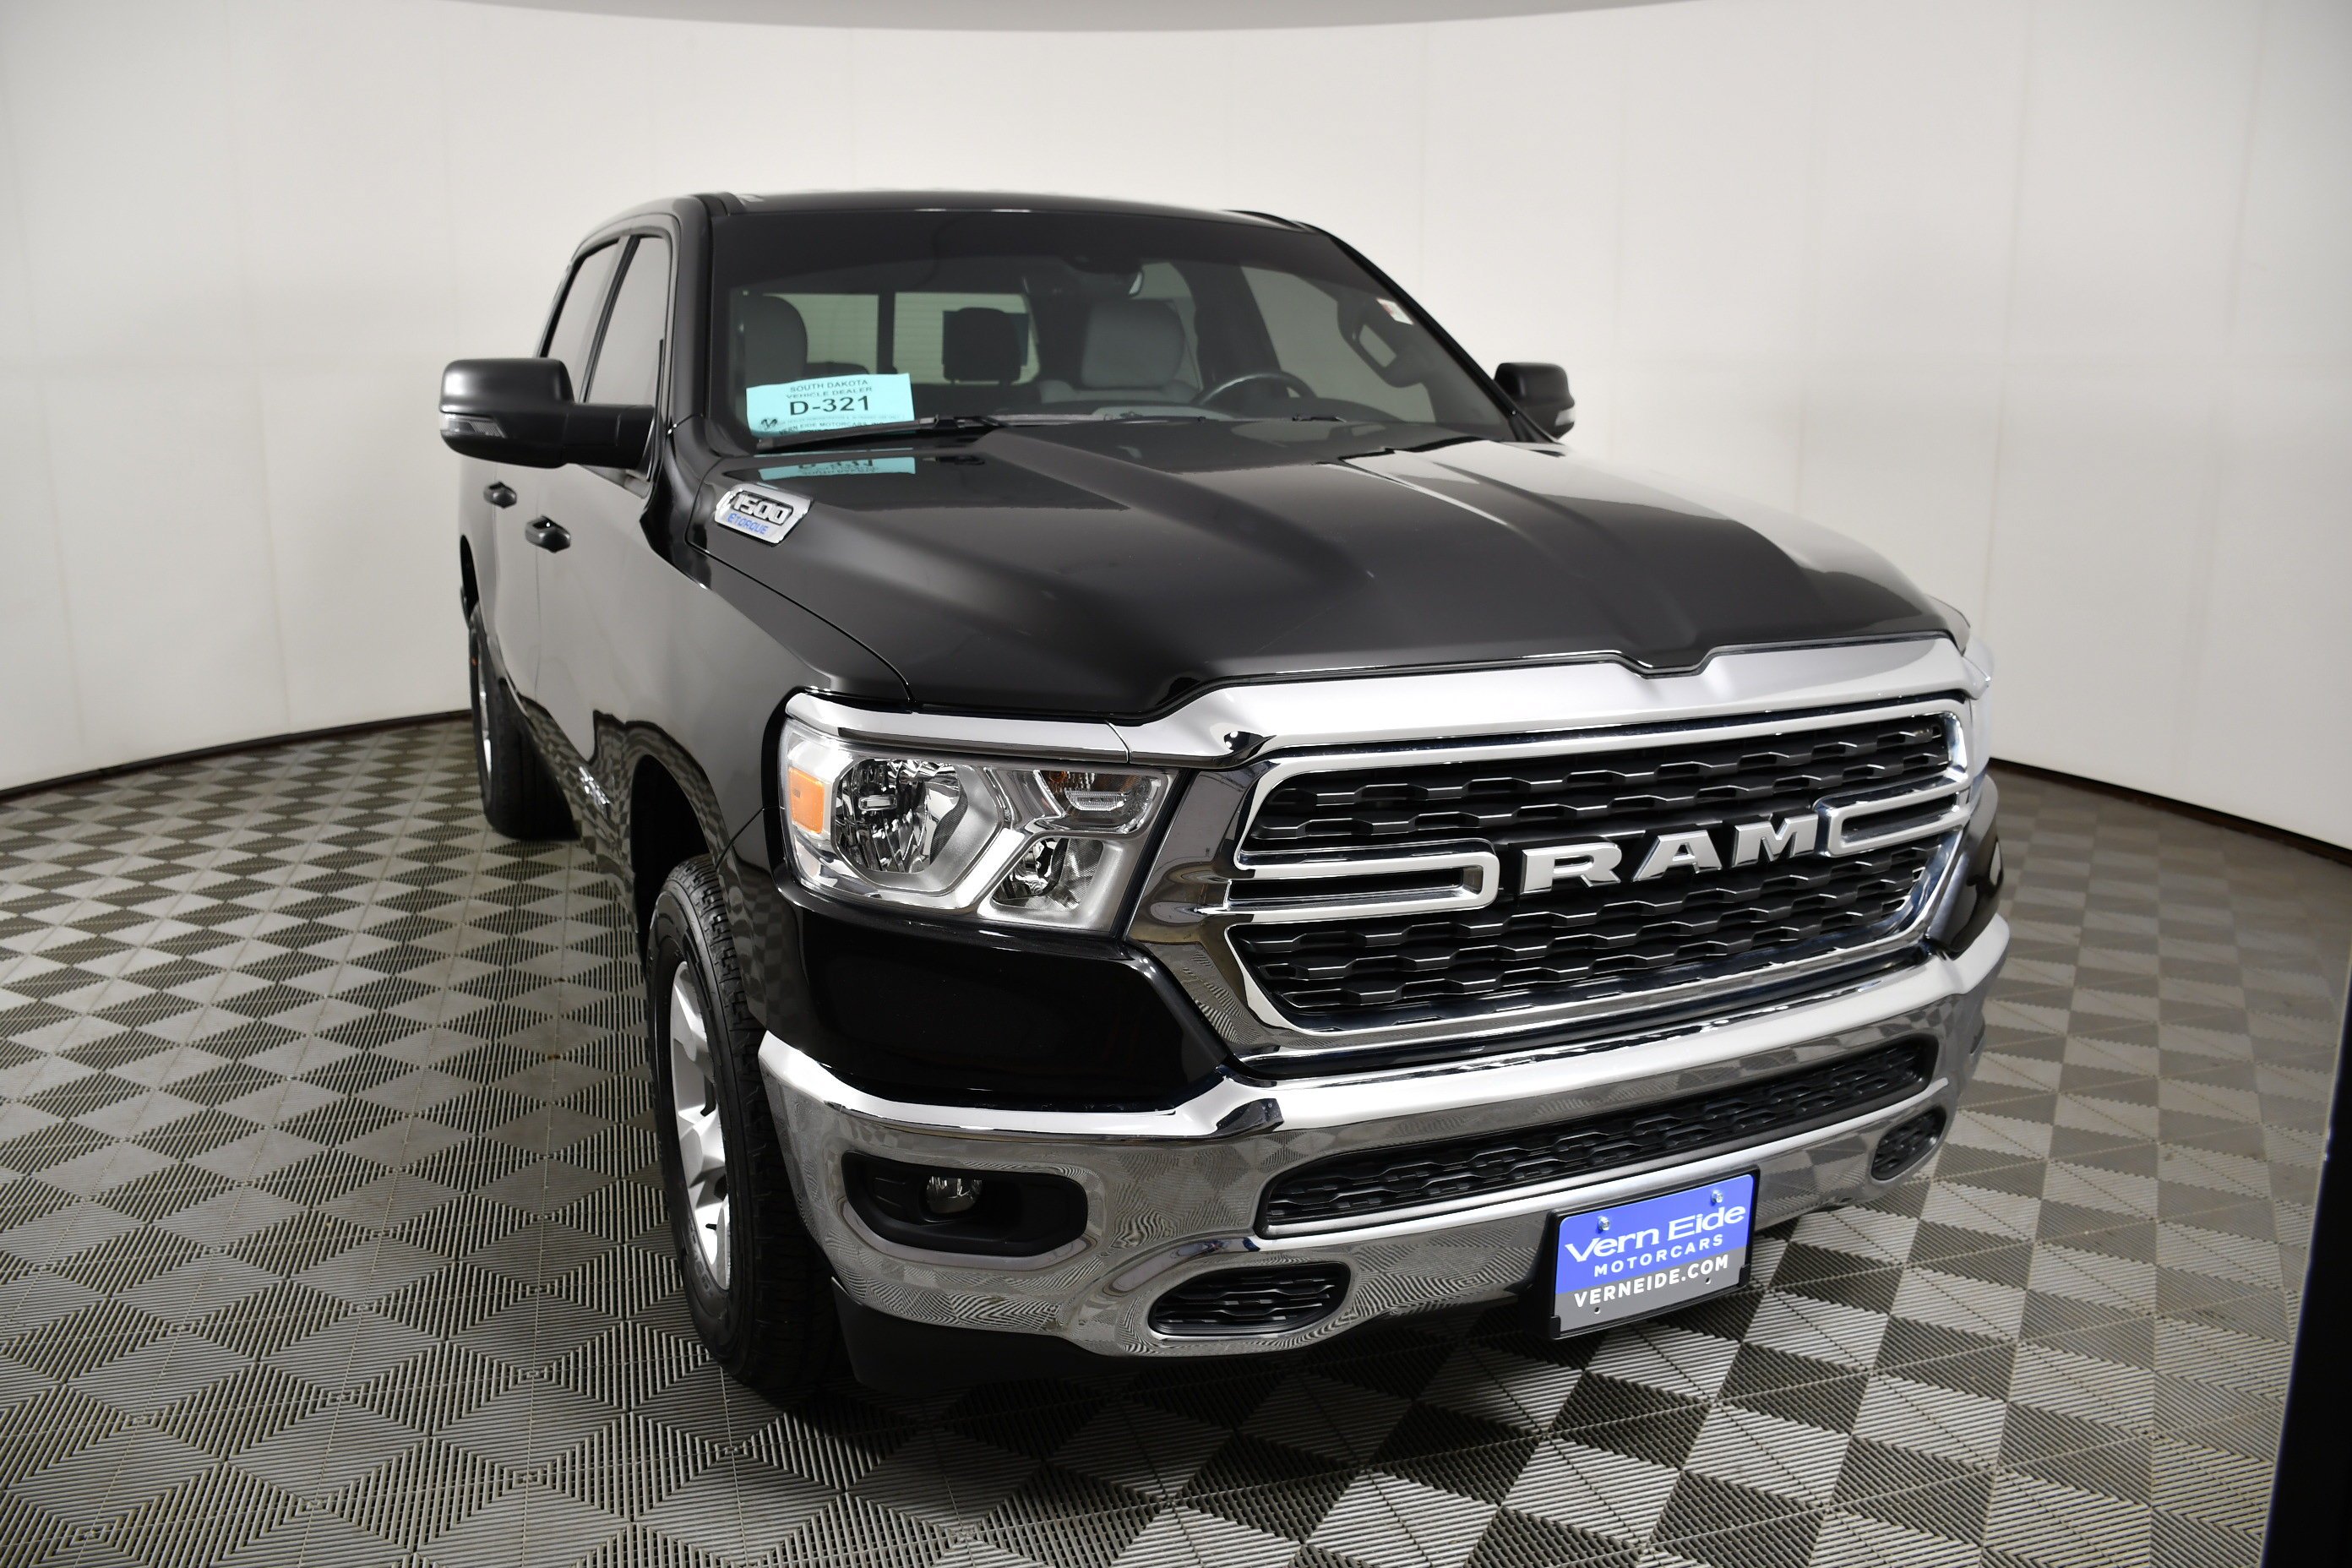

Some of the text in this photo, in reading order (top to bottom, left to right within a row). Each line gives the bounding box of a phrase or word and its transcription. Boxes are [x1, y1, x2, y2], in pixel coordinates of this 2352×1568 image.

[786, 386, 872, 399] VEHICLE DEALER
[790, 379, 868, 392] SOUTH DAKOTA
[790, 395, 868, 415] D-321
[733, 493, 790, 525] 1500
[1519, 812, 1819, 896] RAM
[1565, 1206, 1746, 1263] Vern Eide
[1593, 1233, 1723, 1277] MOTORCARS
[1574, 1254, 1729, 1308] VERNEIDE.COM
